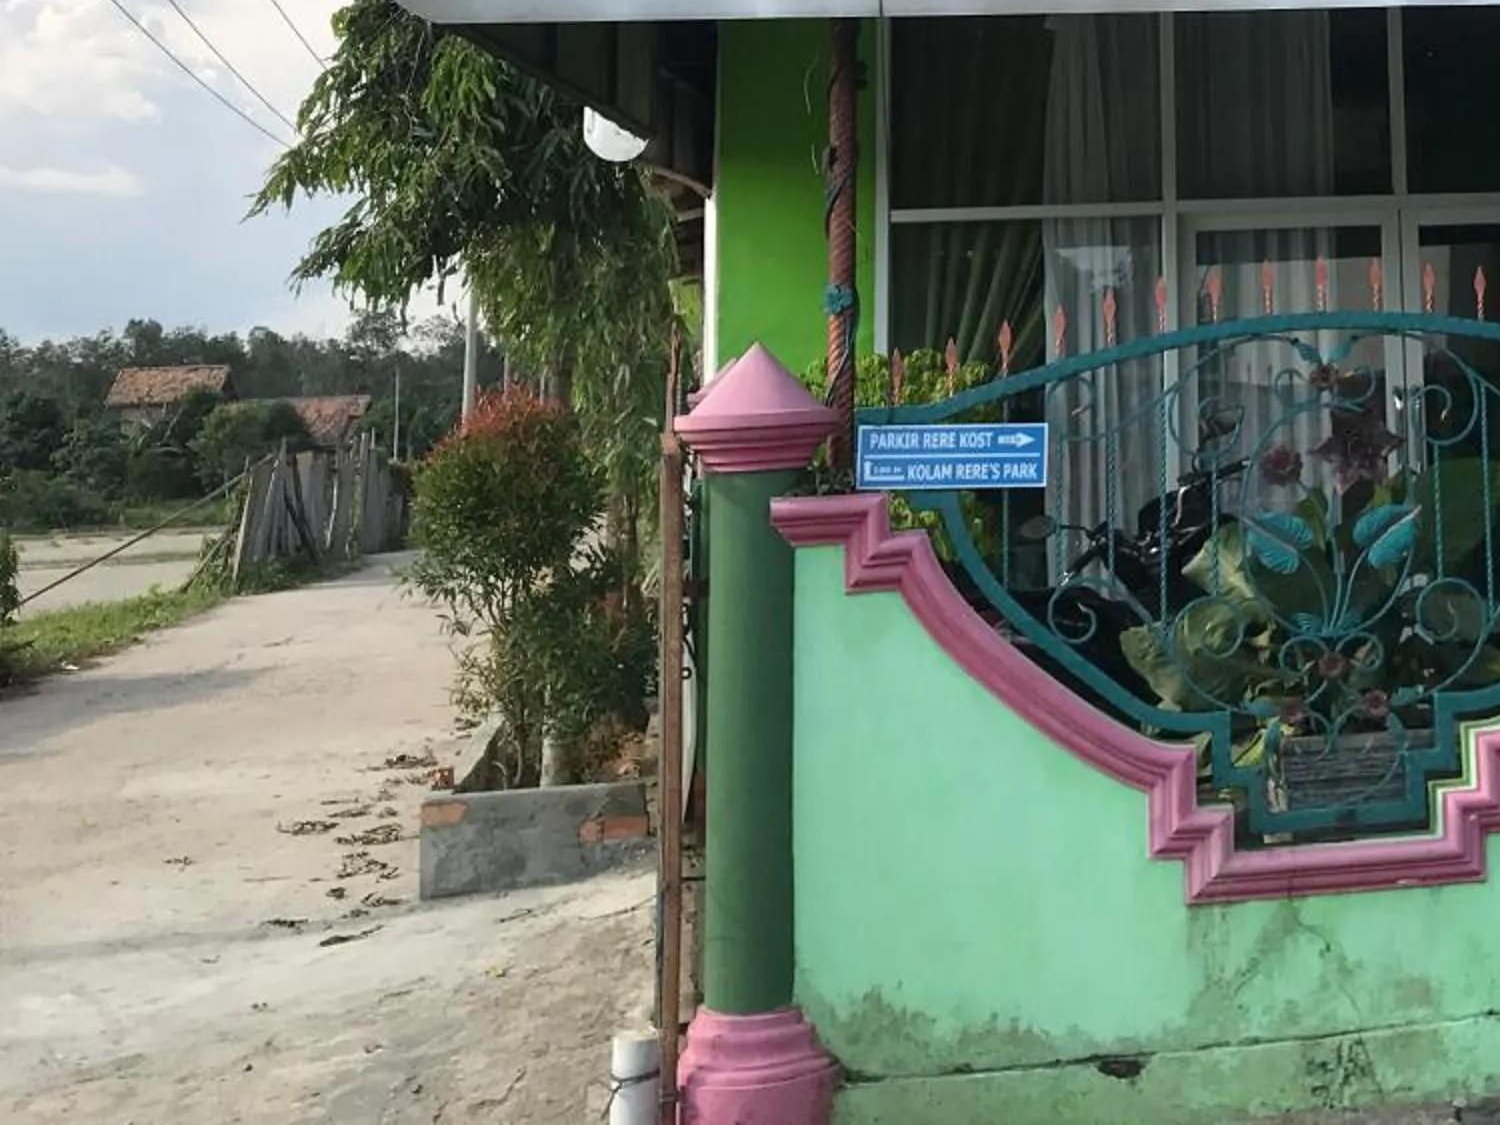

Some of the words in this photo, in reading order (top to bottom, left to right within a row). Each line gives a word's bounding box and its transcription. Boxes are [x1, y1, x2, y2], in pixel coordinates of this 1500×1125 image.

[869, 432, 919, 450] PARKIR
[923, 432, 957, 449] RERE
[959, 431, 993, 448] KOST
[907, 464, 951, 481] KOLAM
[954, 463, 1000, 480] RERE'S
[1003, 462, 1038, 480] PARK
